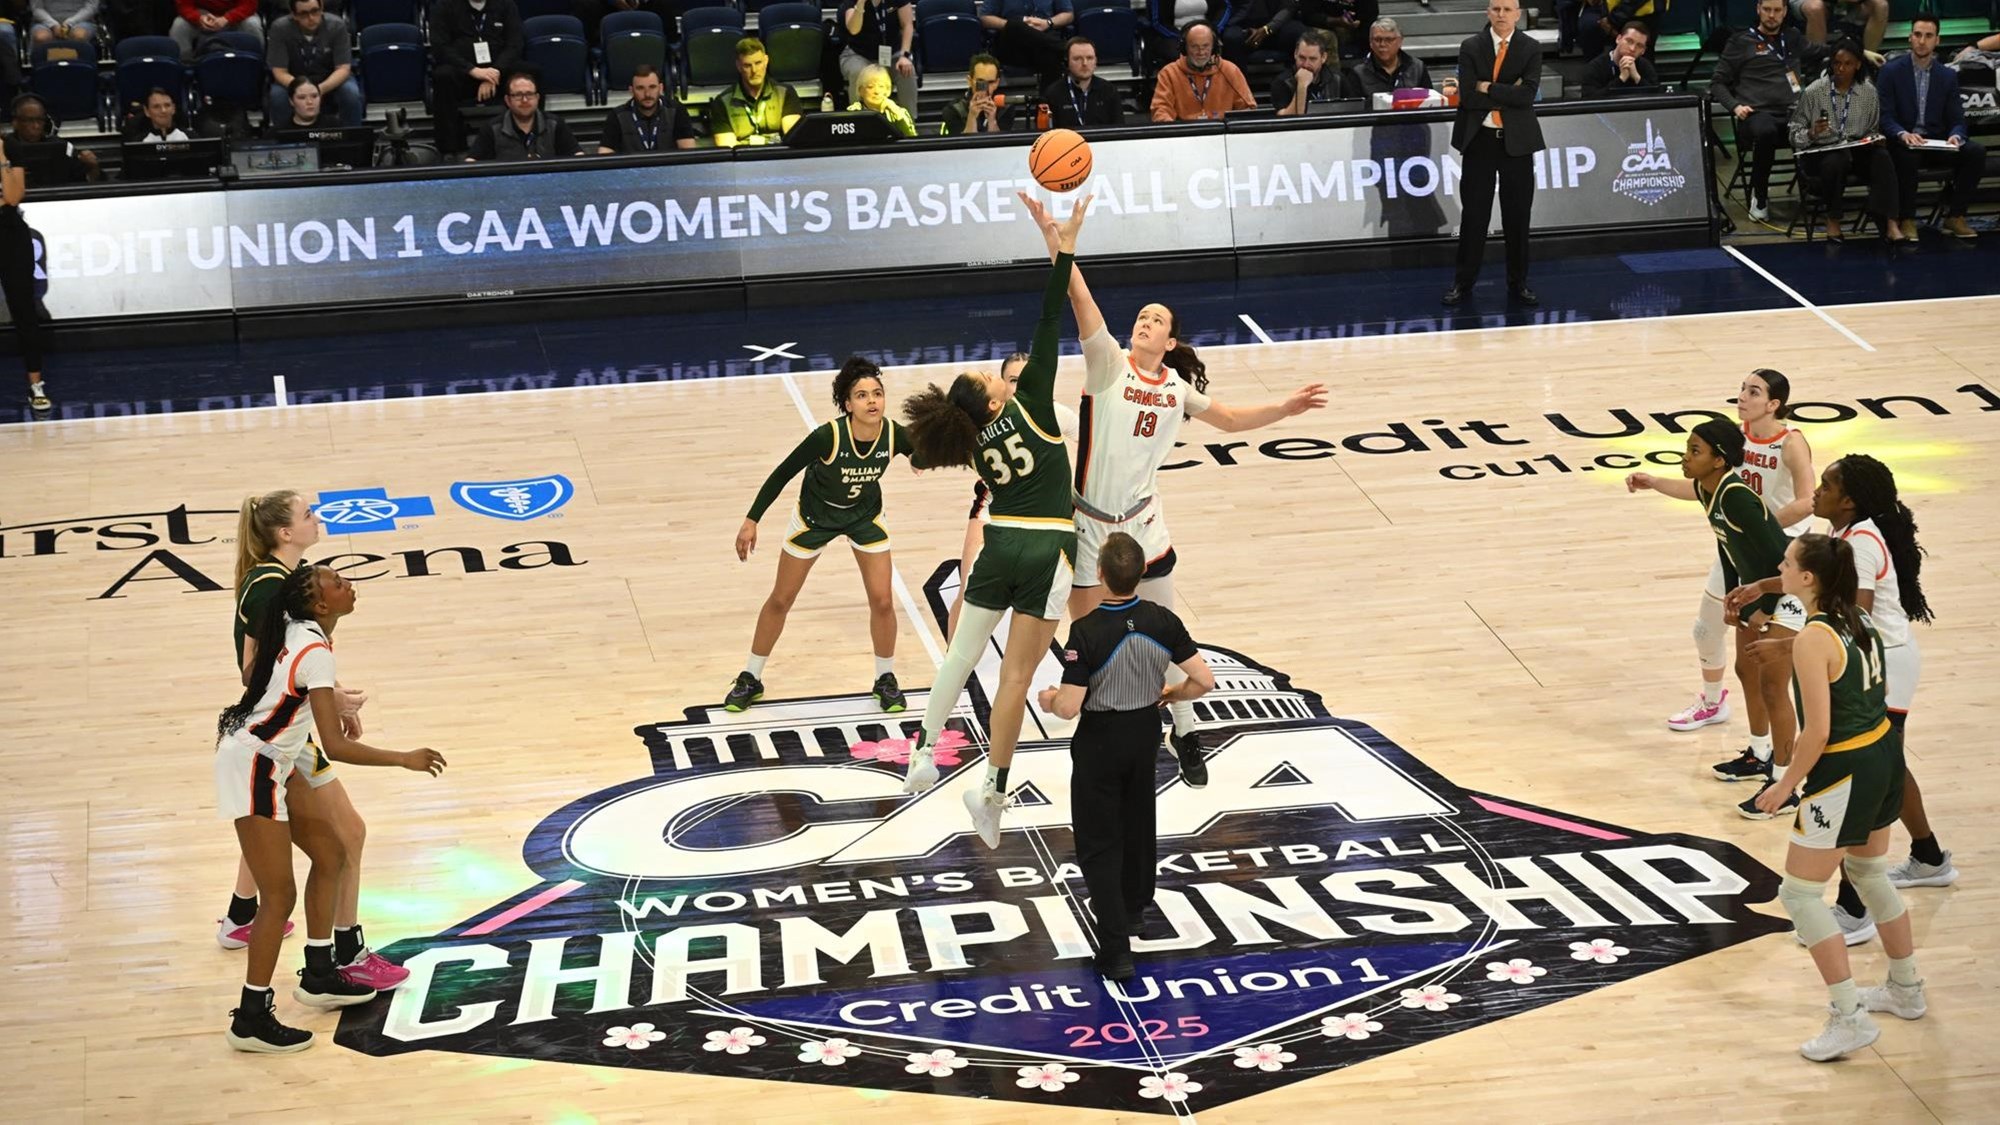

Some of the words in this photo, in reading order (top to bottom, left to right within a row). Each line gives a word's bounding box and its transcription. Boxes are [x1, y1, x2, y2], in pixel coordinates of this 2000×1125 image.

[1960, 92, 1997, 109] CAA
[831, 123, 855, 134] POSS
[1622, 153, 1672, 172] CAA
[1612, 175, 1686, 193] CHAMPIONSHIP
[186, 217, 377, 270] UNION
[393, 214, 423, 259] 1
[436, 206, 553, 255] CAA
[561, 189, 832, 248] WOMEN’S
[1123, 386, 1177, 408] CAMELS
[1133, 410, 1158, 438] 13
[840, 466, 882, 476] WILLIAM
[982, 432, 1035, 485] 35
[1438, 449, 1686, 481] cu1.co
[1743, 450, 1778, 470] MELS
[847, 484, 862, 499] 5
[86, 540, 588, 600] Aena
[1856, 636, 1884, 692] 14
[562, 726, 1459, 880] CAA
[614, 871, 975, 919] WOMEN’S
[996, 833, 1468, 888] BAKETBALL
[839, 983, 1092, 1028] Credit
[1064, 1015, 1211, 1049] 2025
